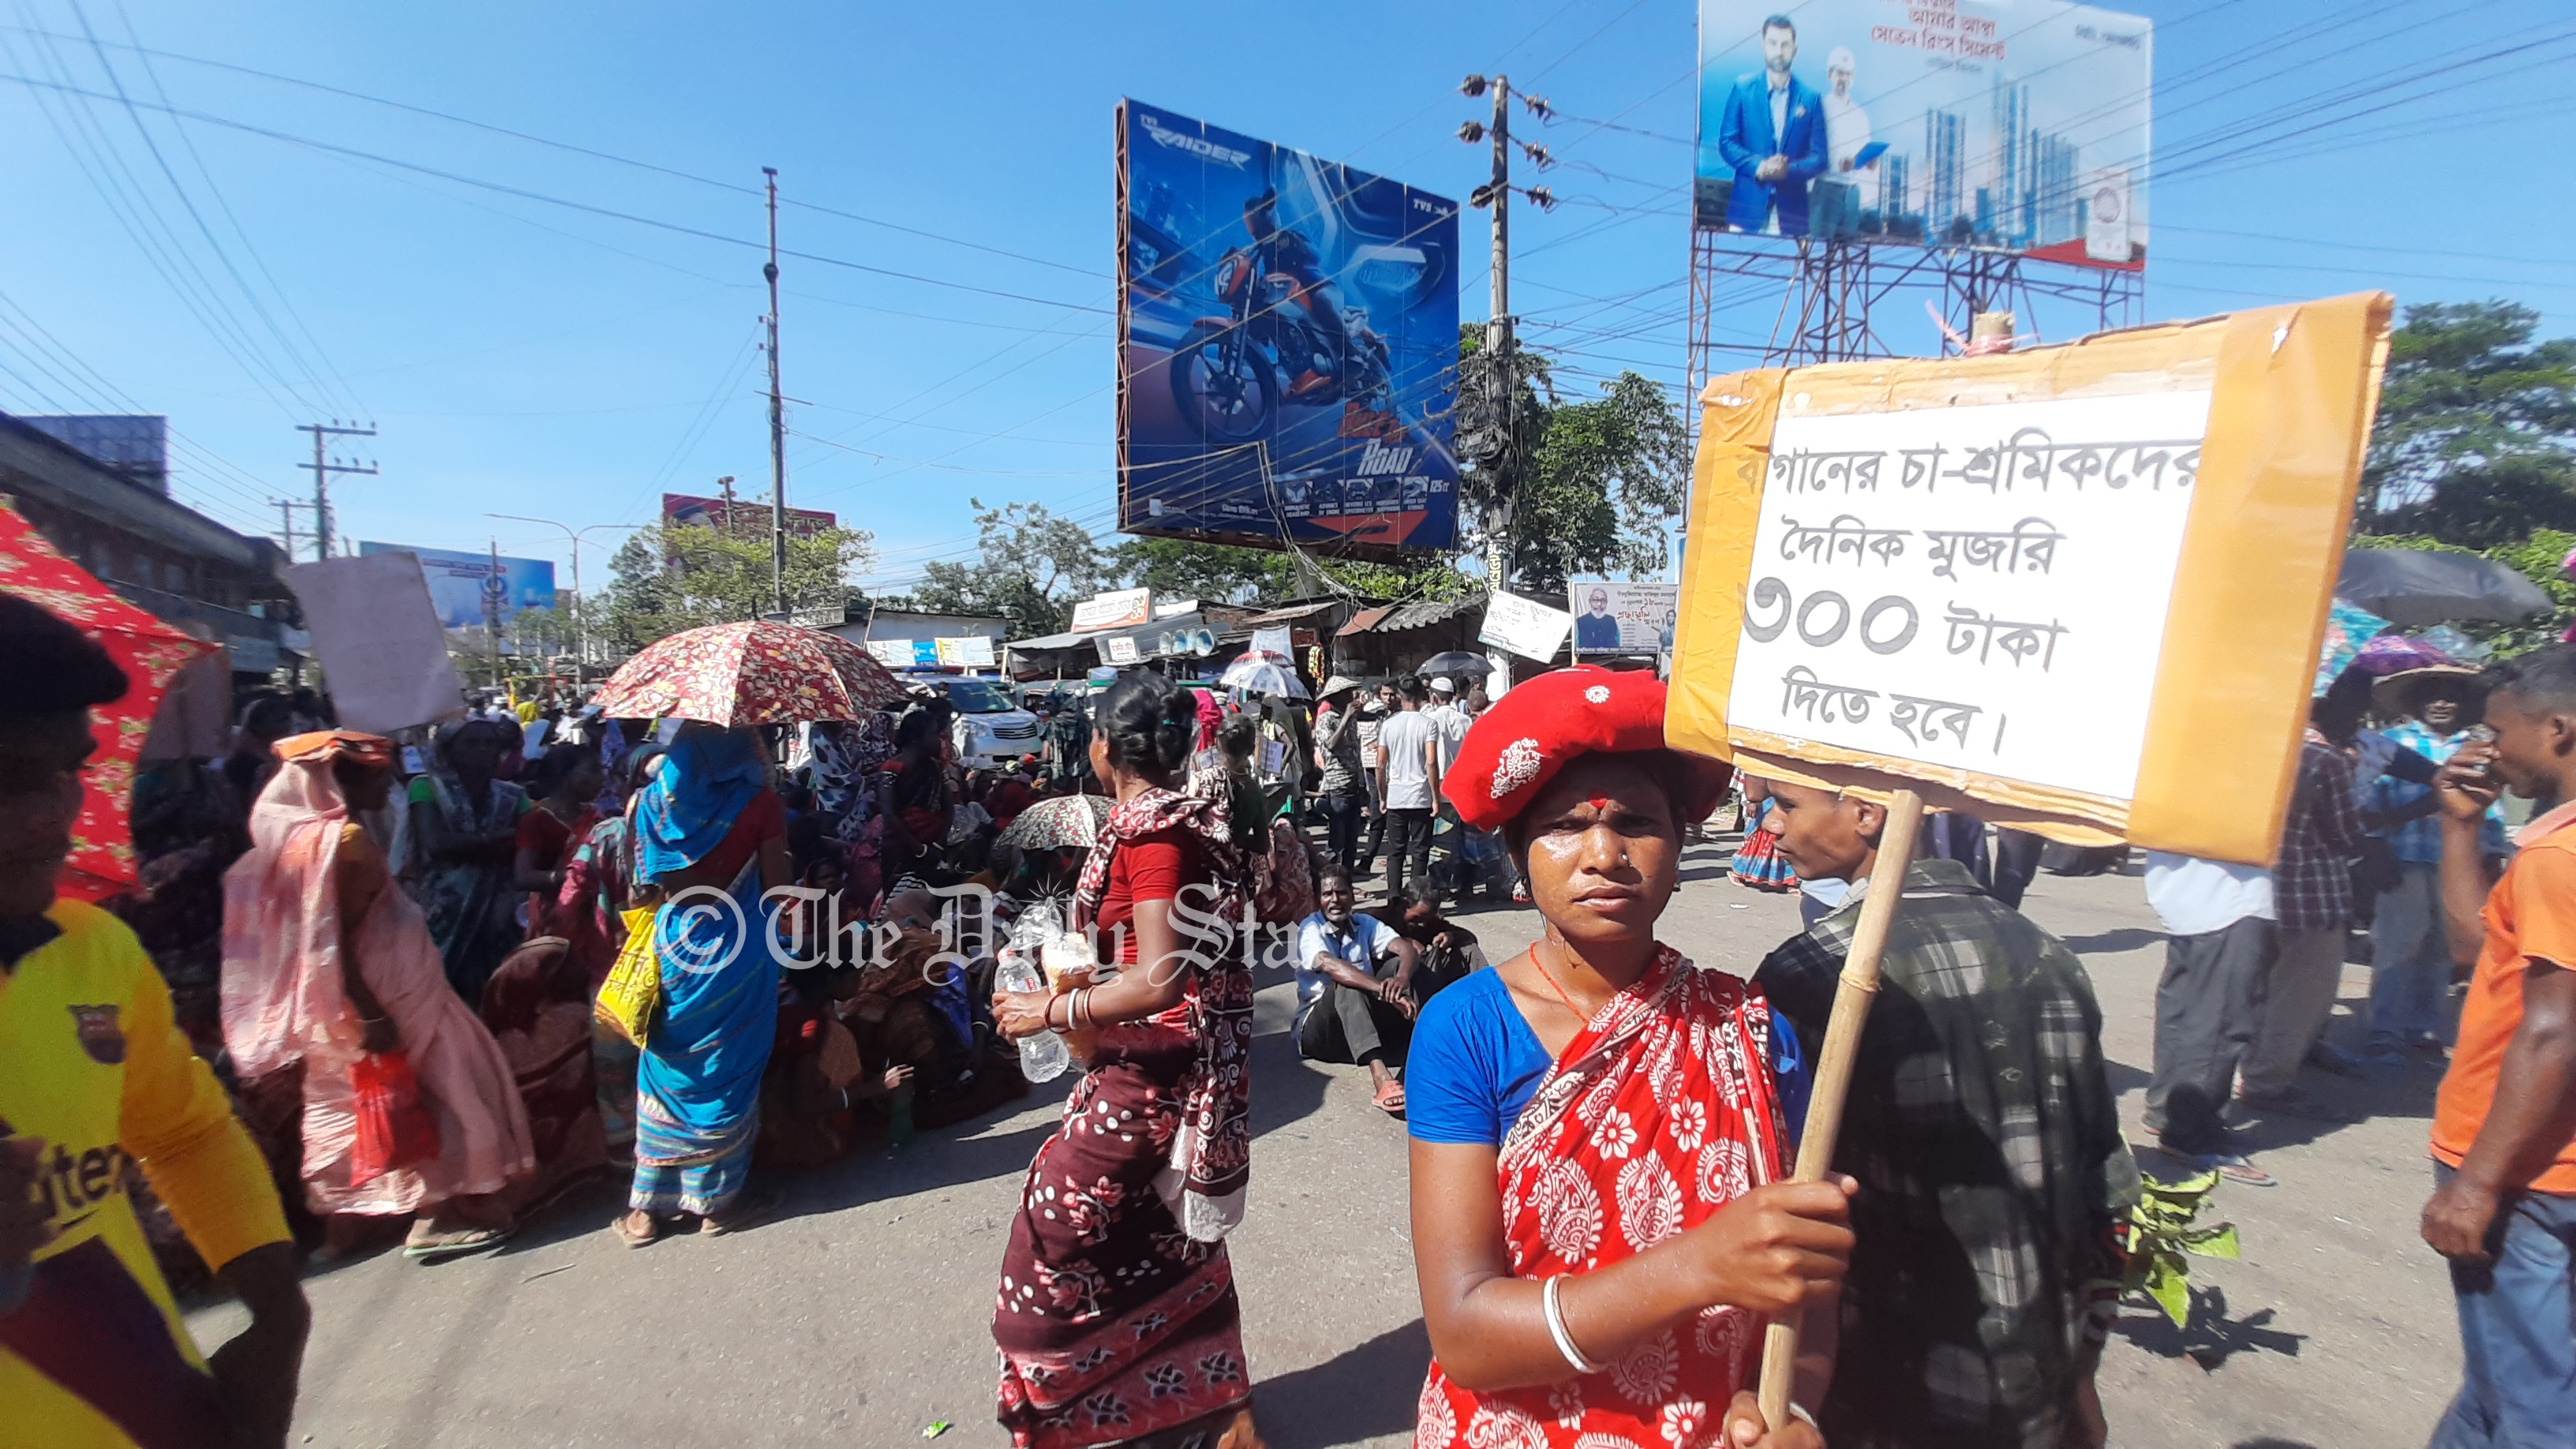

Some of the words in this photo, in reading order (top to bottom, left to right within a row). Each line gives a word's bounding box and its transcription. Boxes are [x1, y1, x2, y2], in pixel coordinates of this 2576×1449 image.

[1144, 125, 1252, 171] RAIDER
[1413, 198, 1432, 212] TVS
[1780, 515, 1911, 567] দৈনিক
[1923, 516, 2068, 582] মুজরি
[1739, 576, 1919, 655] ৩০০
[1943, 600, 2071, 673] টাকা
[1781, 665, 1881, 724] দিতে
[1889, 692, 1983, 750] হবে
